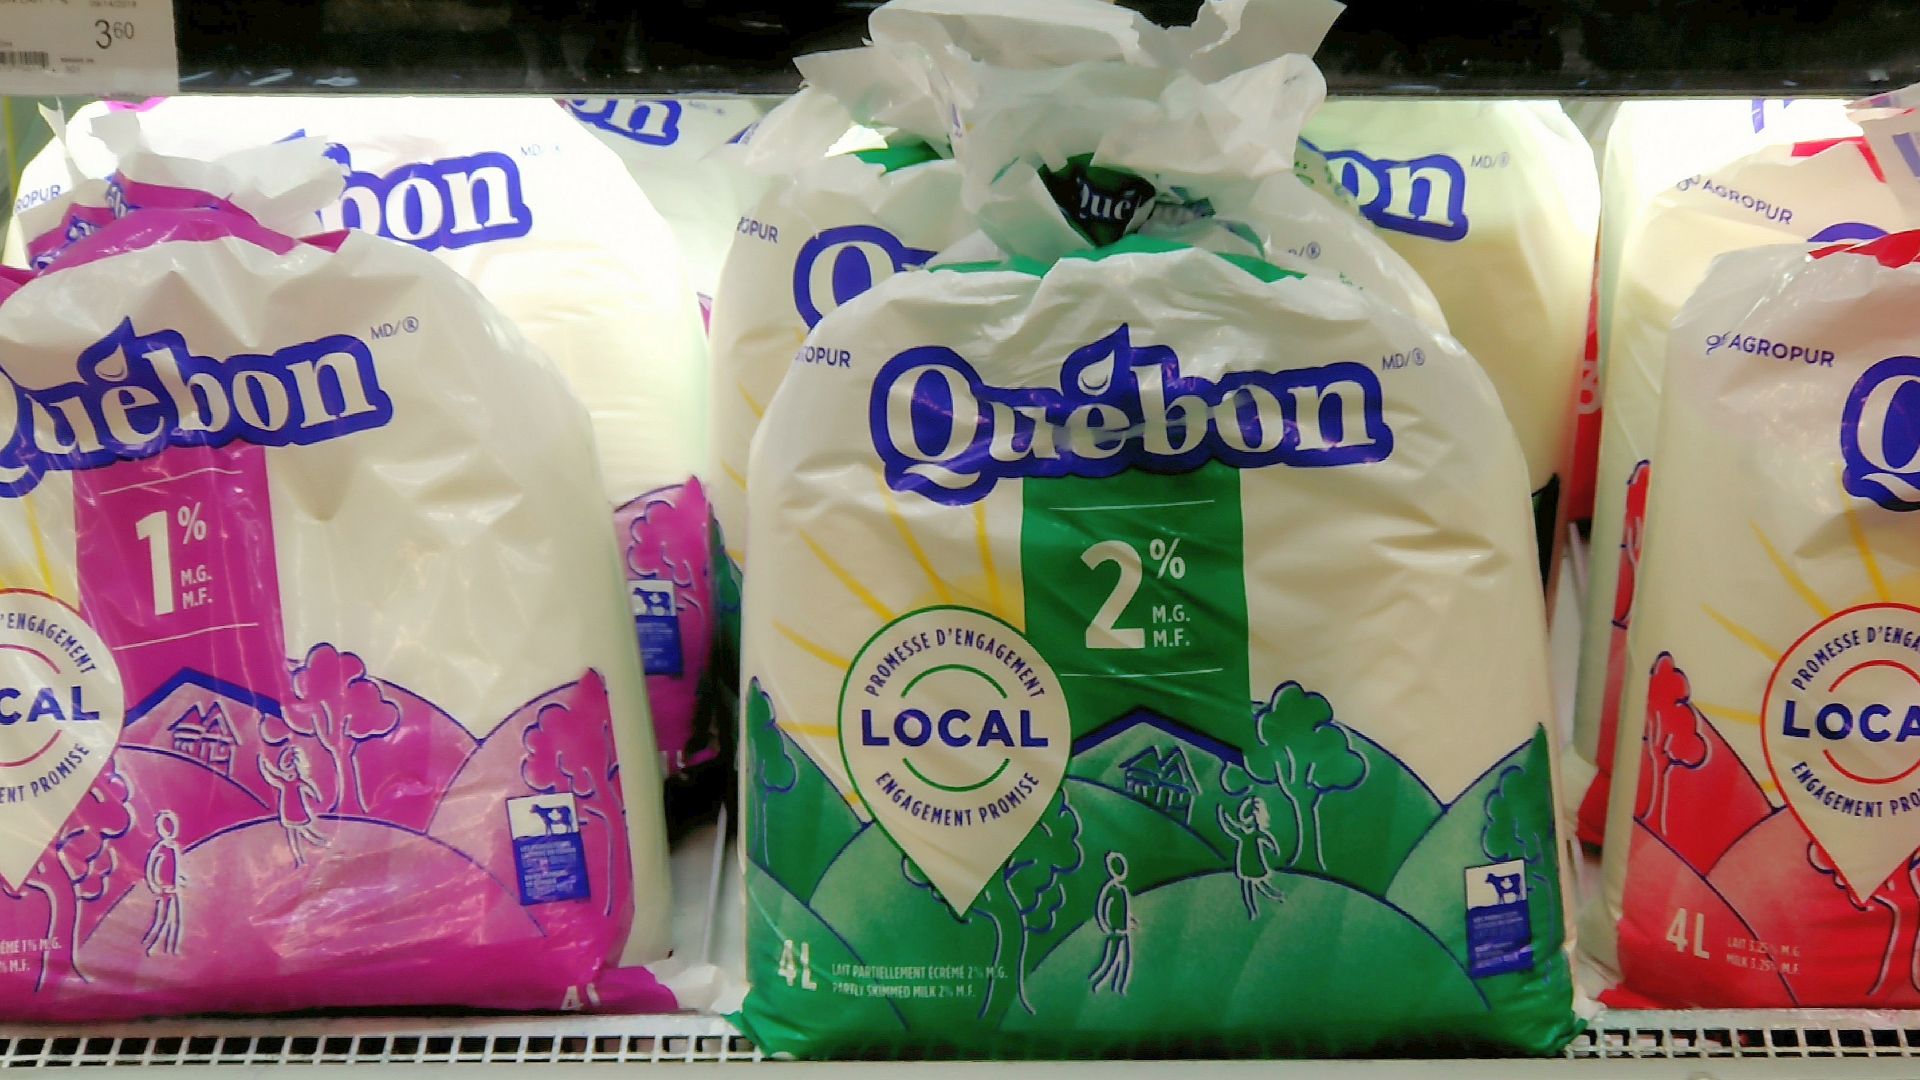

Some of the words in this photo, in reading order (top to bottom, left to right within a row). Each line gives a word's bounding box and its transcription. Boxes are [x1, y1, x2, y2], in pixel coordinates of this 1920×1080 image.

[1703, 179, 1793, 224] AGROPUR
[1728, 333, 1836, 367] AGROPUR
[1151, 604, 1191, 623] M.G.
[1152, 628, 1191, 648] M.F.
[864, 632, 930, 697] PROMESSE
[935, 627, 1046, 698] D'ENGAGEMENT
[1791, 629, 1862, 691] PROMESSE
[861, 707, 1049, 748] LOCAL
[30, 742, 90, 798] PROMISE
[1790, 761, 1884, 818] ENGAGEMENT
[875, 772, 972, 827] ENGAGEMENT
[979, 772, 1040, 823] PROMISE
[1665, 907, 1711, 959] 4L
[777, 938, 818, 992] 4L
